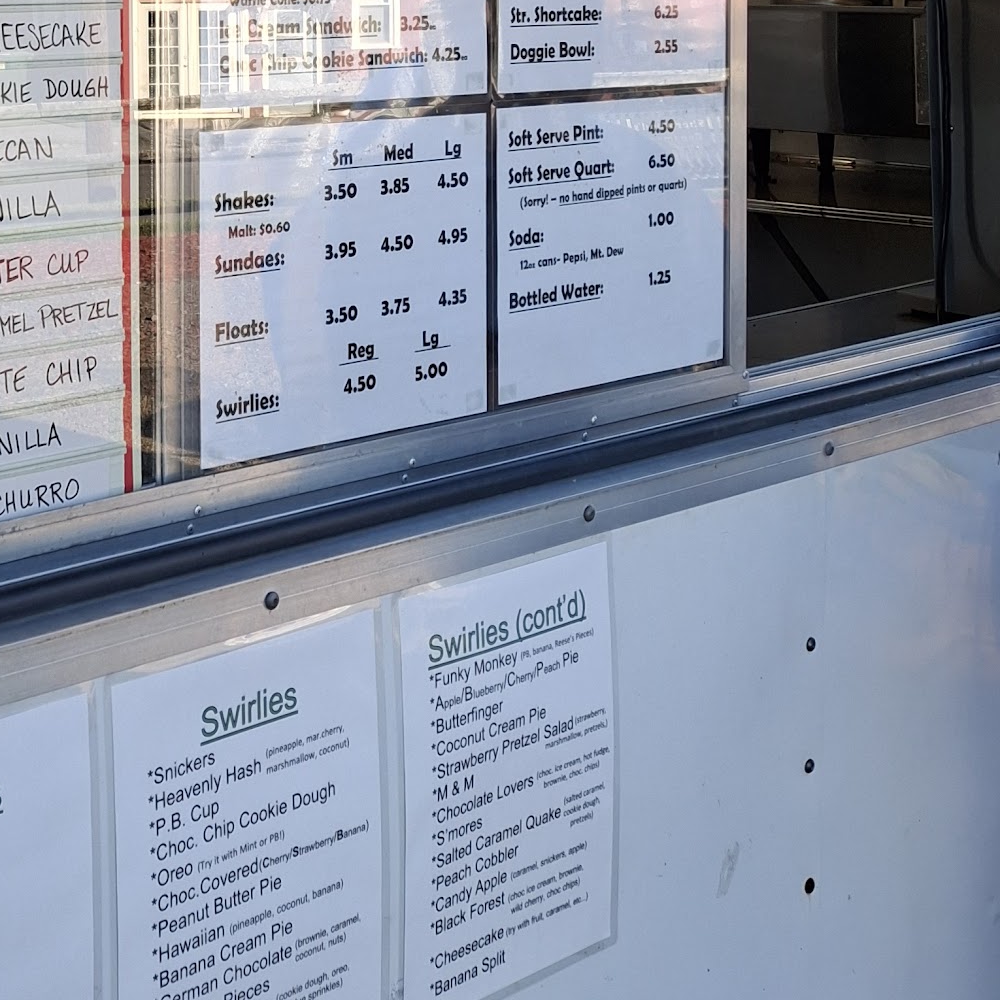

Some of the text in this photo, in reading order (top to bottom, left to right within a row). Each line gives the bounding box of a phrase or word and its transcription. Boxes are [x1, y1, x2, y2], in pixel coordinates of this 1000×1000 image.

[510, 4, 679, 25] Str. Shortcake: 6.25
[510, 39, 679, 63] Doggie Bowl: 2.55
[508, 129, 533, 149] Soft
[536, 127, 570, 145] Serve
[572, 123, 604, 143] Pint:
[648, 118, 676, 134] 4.50
[331, 139, 462, 167] Sm Med Lg
[214, 171, 469, 213] Shakes: 3.50 3.85 4.50
[520, 177, 688, 211] (Sorry! no hand dipped pints or quarts)
[228, 220, 291, 240] Malt: $0.60
[508, 211, 675, 248] Soda: 1.00
[508, 282, 604, 310] Bottled Water:
[46, 355, 98, 387] CHIP
[215, 361, 448, 420] Swirlies: 4.50 5.00
[429, 588, 587, 664] Swirlies (cont'd)
[200, 686, 298, 739] Swirlies
[488, 706, 547, 739] Cream Pie
[502, 715, 574, 756] Pretzel Salad
[225, 758, 263, 785] Hash
[239, 781, 336, 830] Cookie Dough
[312, 877, 344, 901] banana)
[475, 870, 508, 897] Apple
